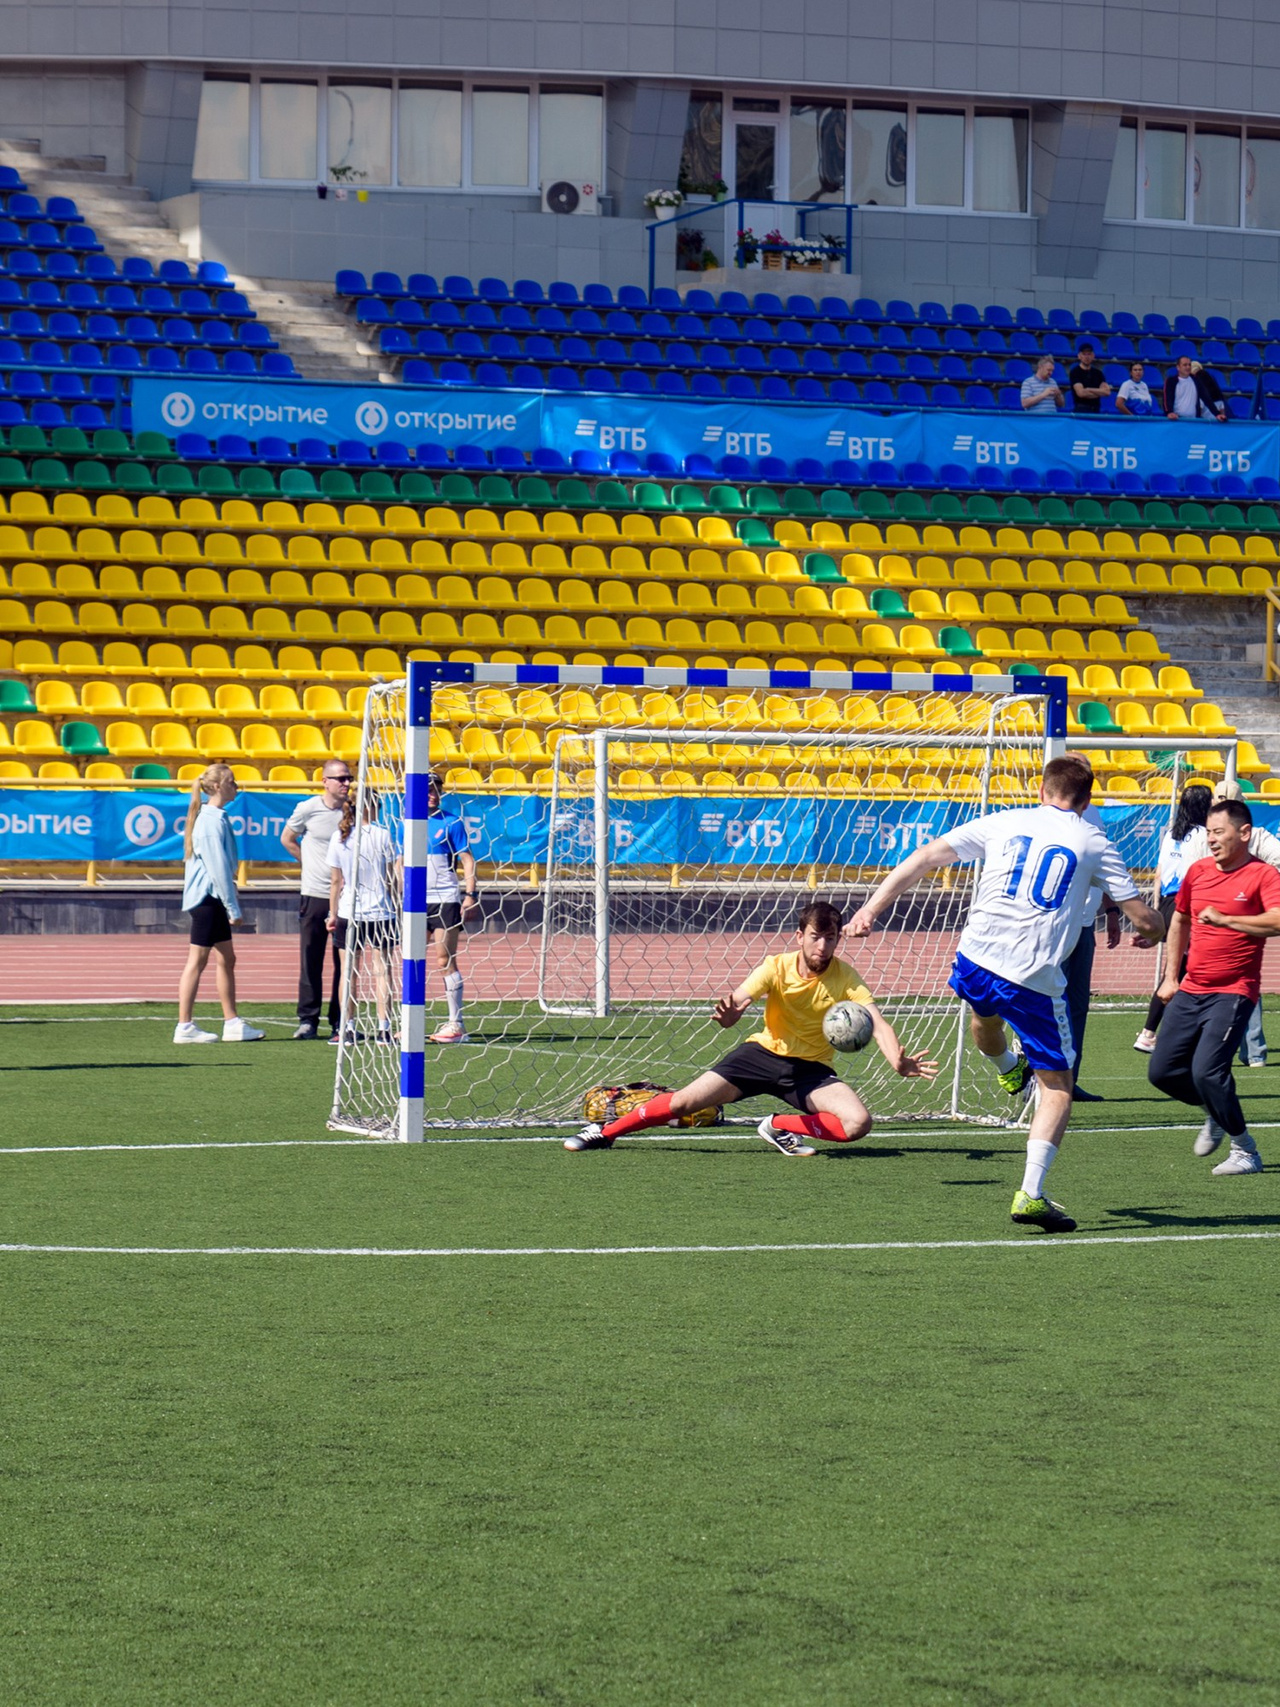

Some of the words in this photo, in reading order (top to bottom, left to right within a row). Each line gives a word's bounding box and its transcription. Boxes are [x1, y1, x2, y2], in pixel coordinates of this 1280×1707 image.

[202, 402, 329, 427] открытие
[395, 410, 517, 435] открытие
[600, 426, 647, 451] ВТБ
[726, 432, 771, 456] ВТБ
[848, 437, 895, 461] ВТБ
[976, 442, 1020, 465] ВТБ
[1093, 446, 1138, 470] ВТБ
[1209, 450, 1251, 472] ВТБ
[579, 819, 633, 846] ВБ
[726, 819, 783, 847] ВТБ
[879, 822, 935, 850] ВТБ
[1002, 835, 1078, 912] 10
